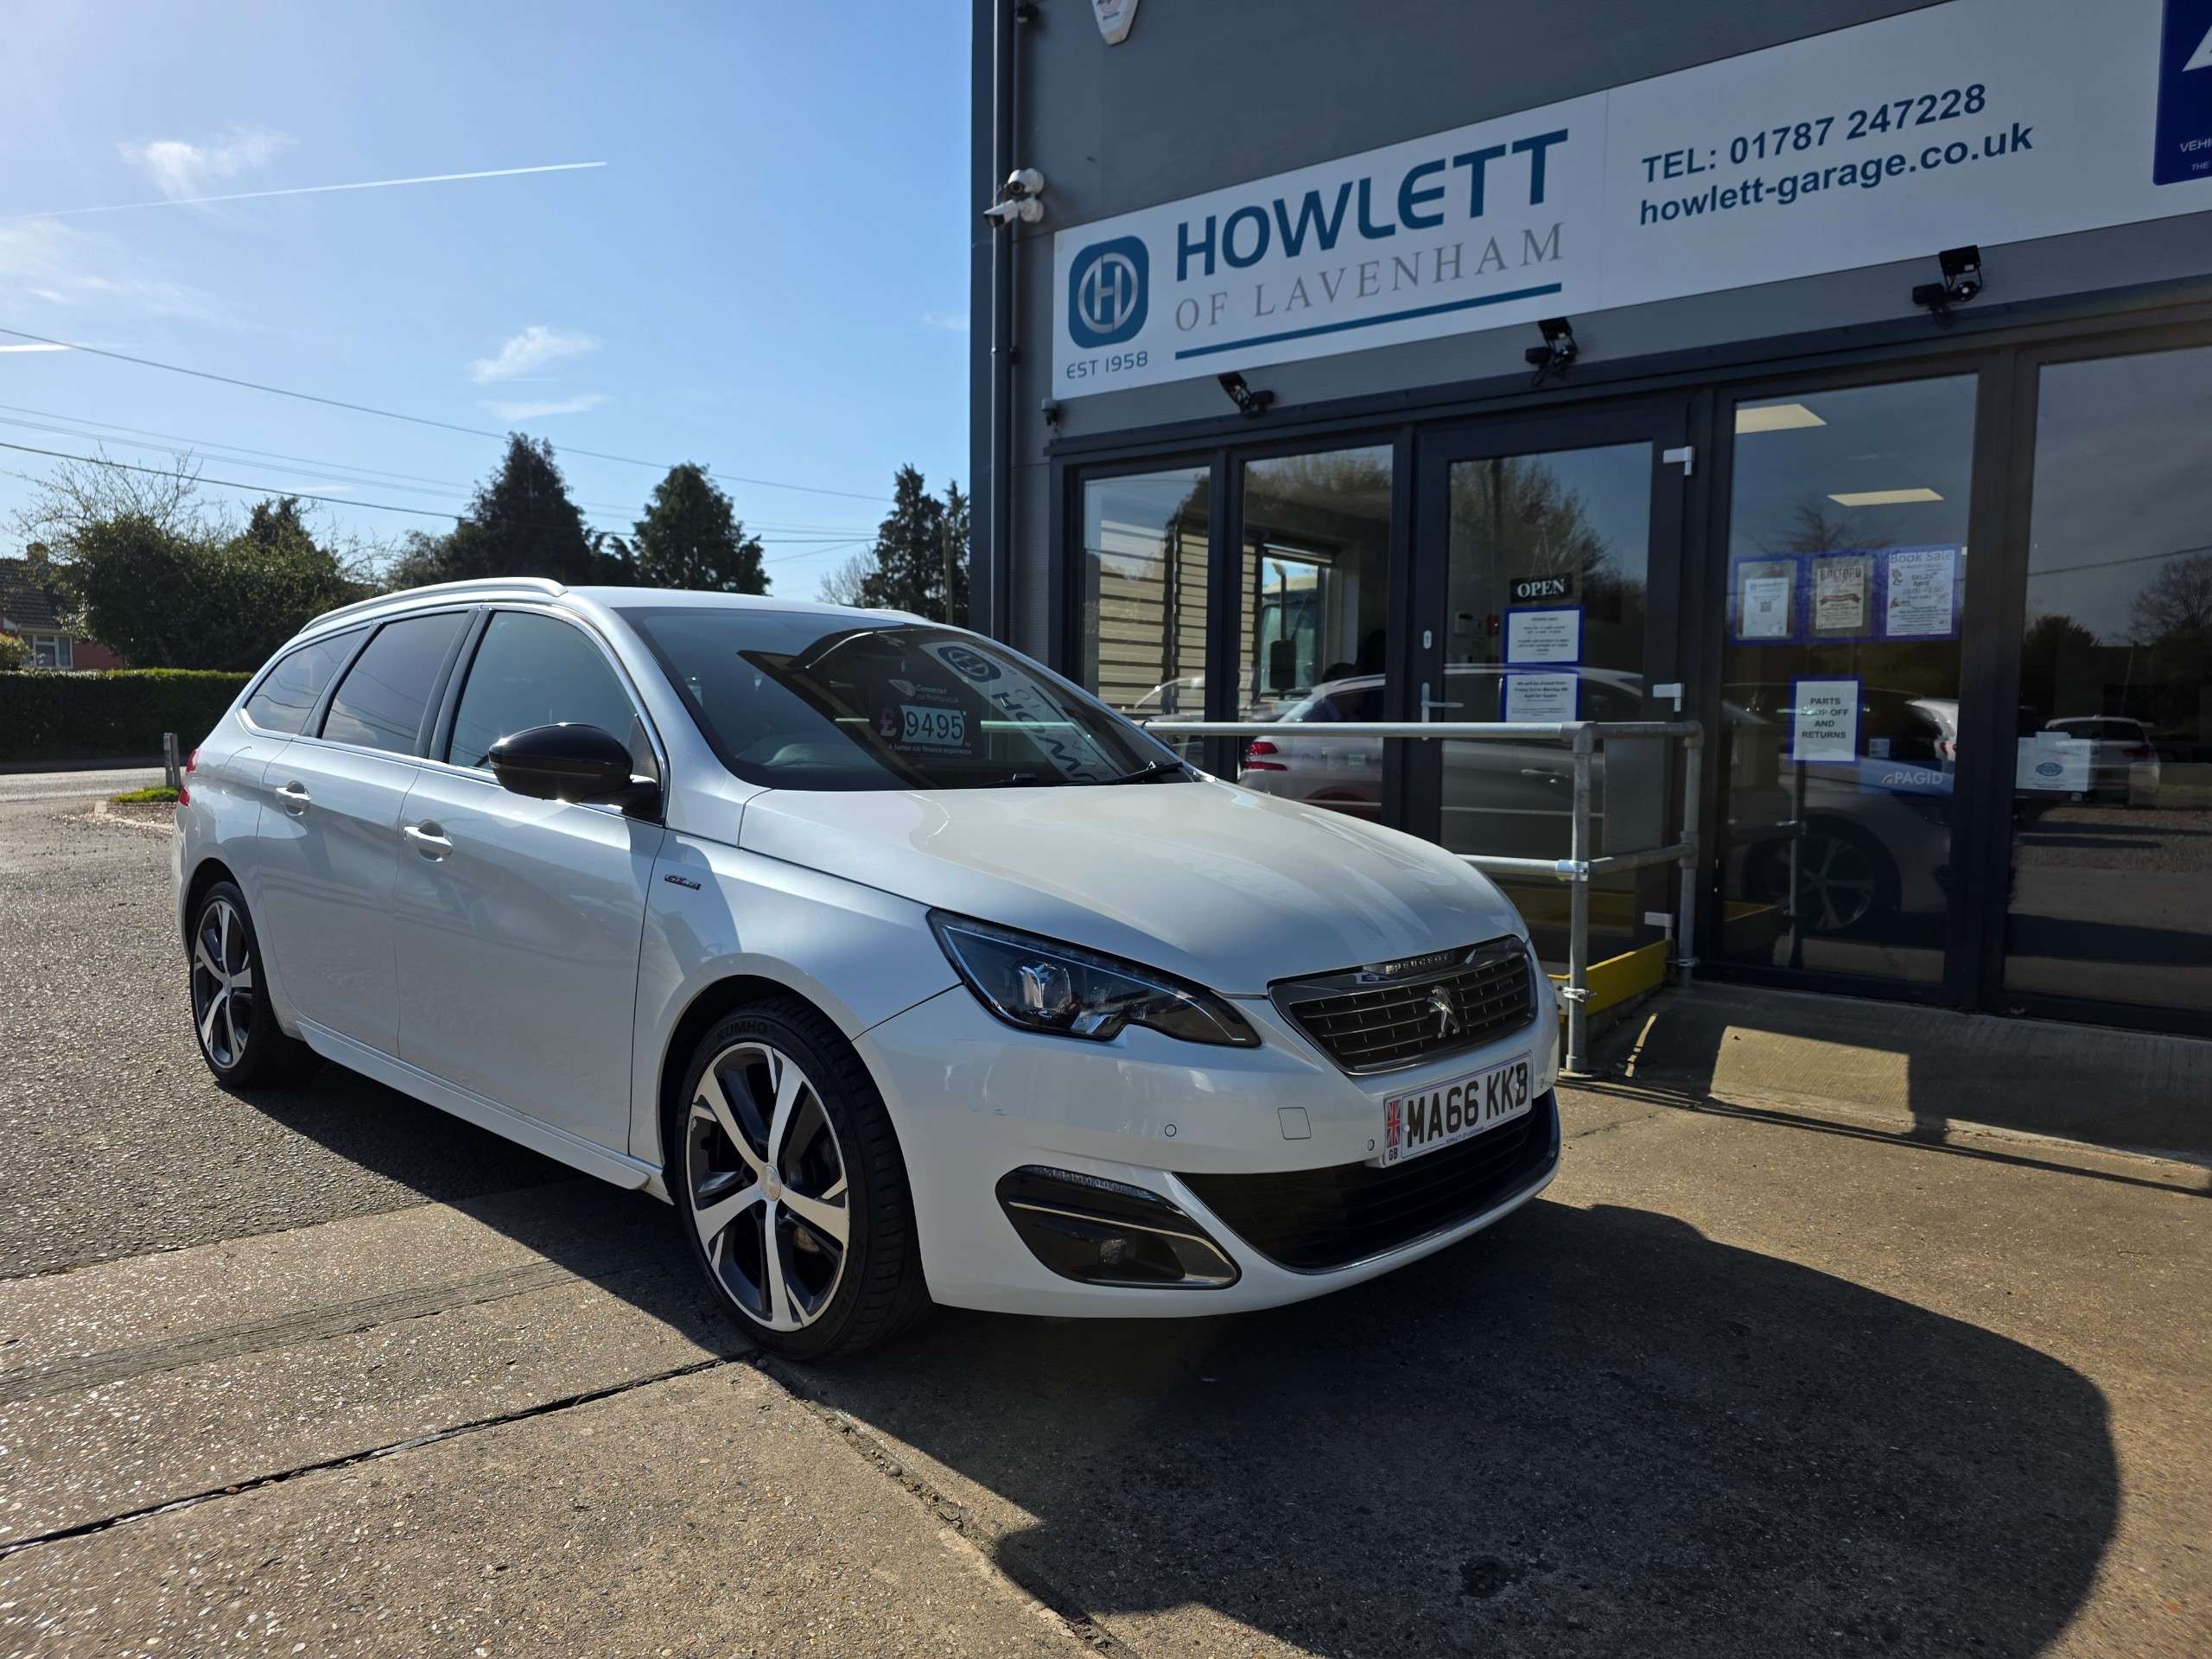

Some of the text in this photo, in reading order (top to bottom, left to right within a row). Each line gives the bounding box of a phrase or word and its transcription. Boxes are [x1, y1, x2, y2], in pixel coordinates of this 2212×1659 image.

[1642, 83, 1986, 183] TEL: 01787 247228
[2179, 137, 2212, 154] VEHI
[1639, 121, 2035, 226] howlett-garage.co.uk
[1176, 128, 1569, 283] HOWLETT
[1175, 221, 1565, 333] OF LAVENHAM
[1065, 350, 1149, 379] EST 1958
[1516, 578, 1566, 599] OPEN
[1810, 696, 1841, 706] PARTS
[1830, 708, 1850, 716] OFF
[906, 710, 963, 741] 9495
[1814, 719, 1835, 728] AND
[1802, 730, 1847, 739] RETURNS
[1894, 772, 1943, 785] PAGID
[1407, 1062, 1529, 1148] MA66 KKB
[1389, 1148, 1399, 1161] GB
